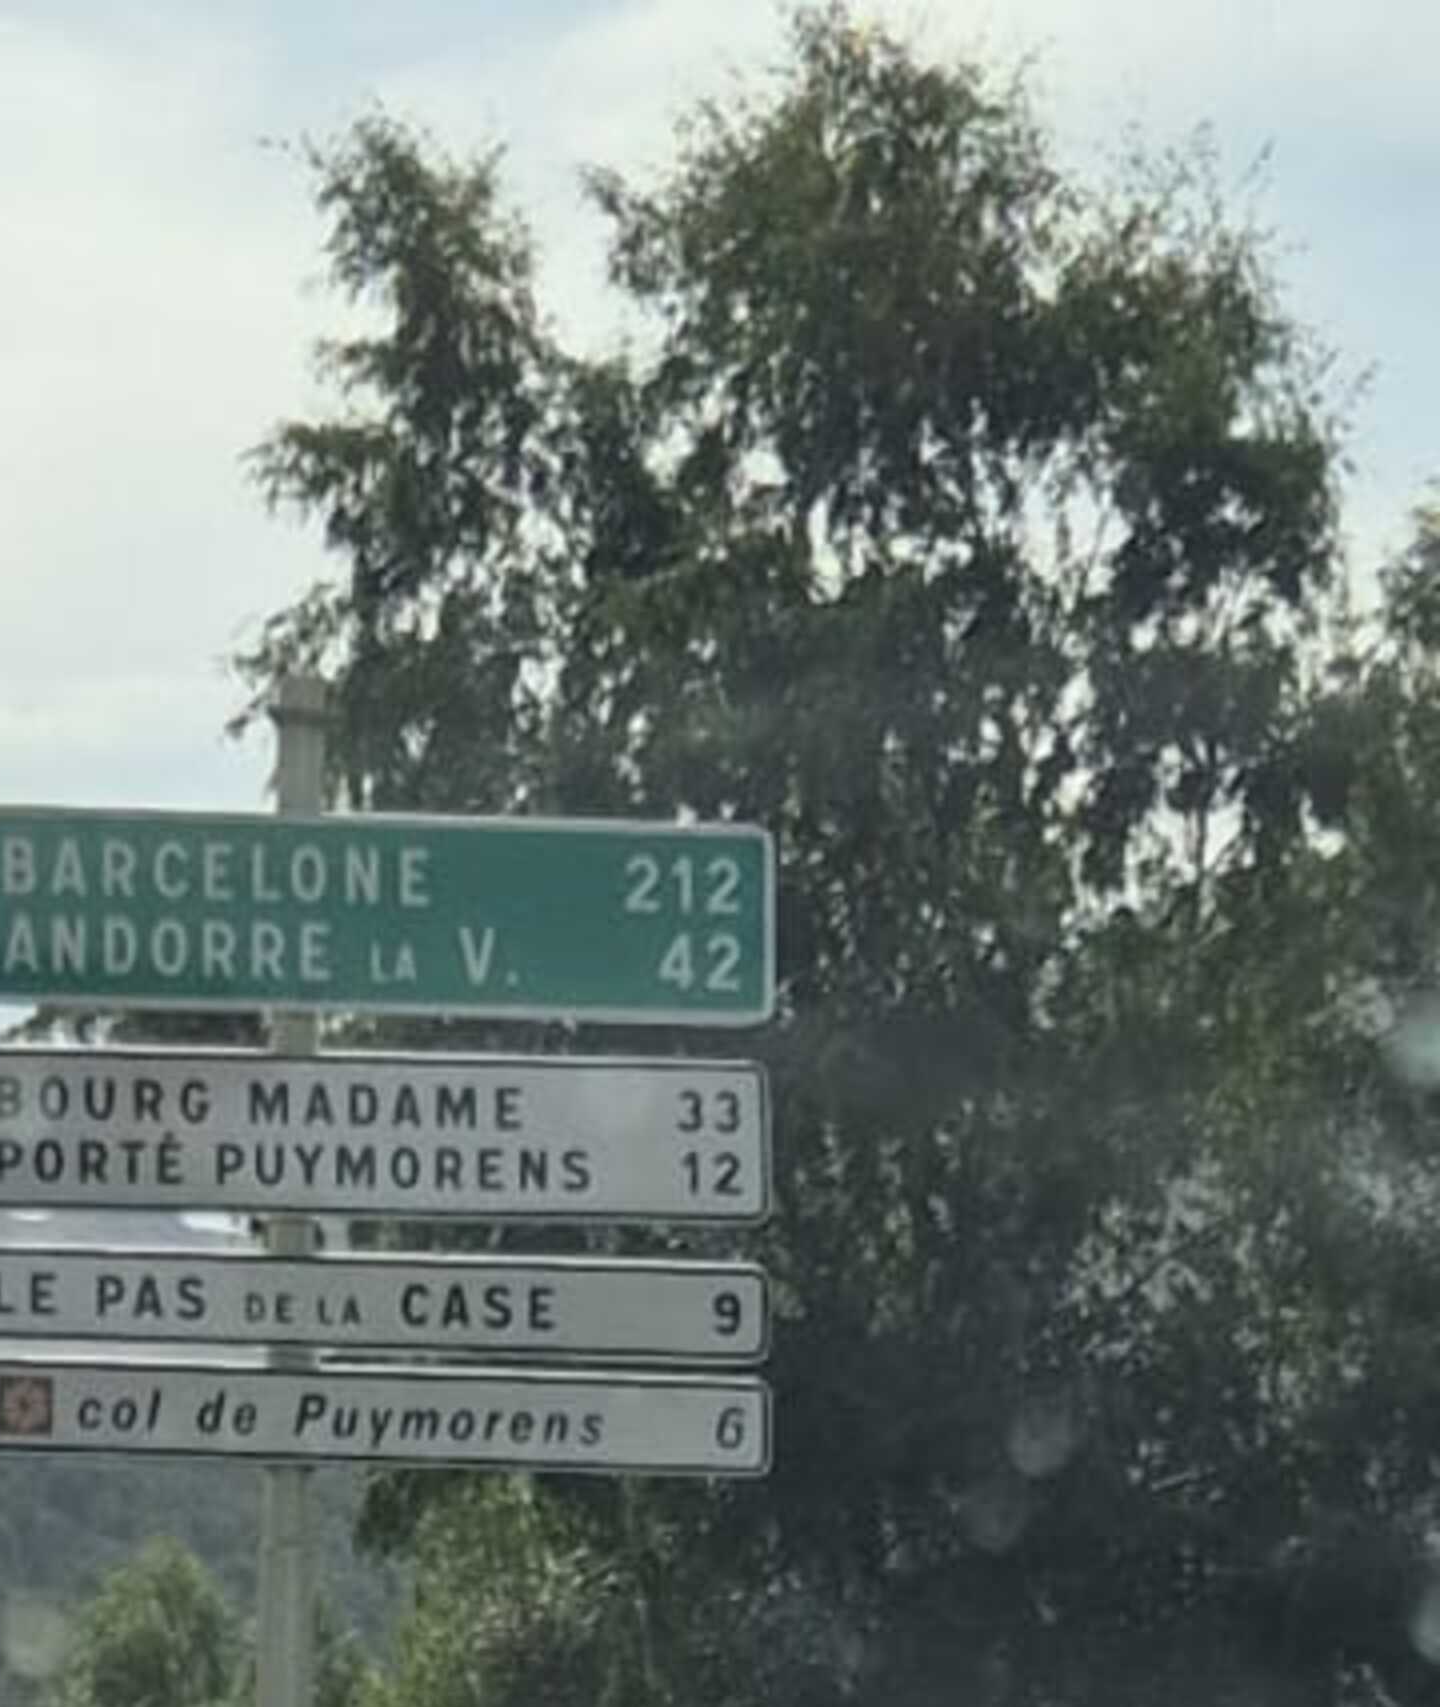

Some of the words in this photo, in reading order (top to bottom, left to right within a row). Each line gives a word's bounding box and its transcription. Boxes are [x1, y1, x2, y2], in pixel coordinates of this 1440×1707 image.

[2, 838, 431, 908] BARCELONE
[624, 857, 742, 914] 212
[3, 916, 333, 982] ANDORRE
[370, 946, 418, 984] LA
[461, 927, 520, 987] V.
[659, 935, 742, 992] 42
[248, 1081, 524, 1132] MADAME
[677, 1091, 742, 1134] 33
[216, 1142, 593, 1193] PUYMORENS
[682, 1151, 744, 1196] 12
[96, 1275, 207, 1320] PAS
[245, 1292, 294, 1325] DE
[317, 1293, 362, 1326] LA
[400, 1283, 557, 1332] CASE
[712, 1292, 743, 1336] 9
[77, 1390, 161, 1431] col
[196, 1390, 257, 1437] de
[294, 1392, 606, 1450] Puymorens
[715, 1403, 746, 1448] 6
